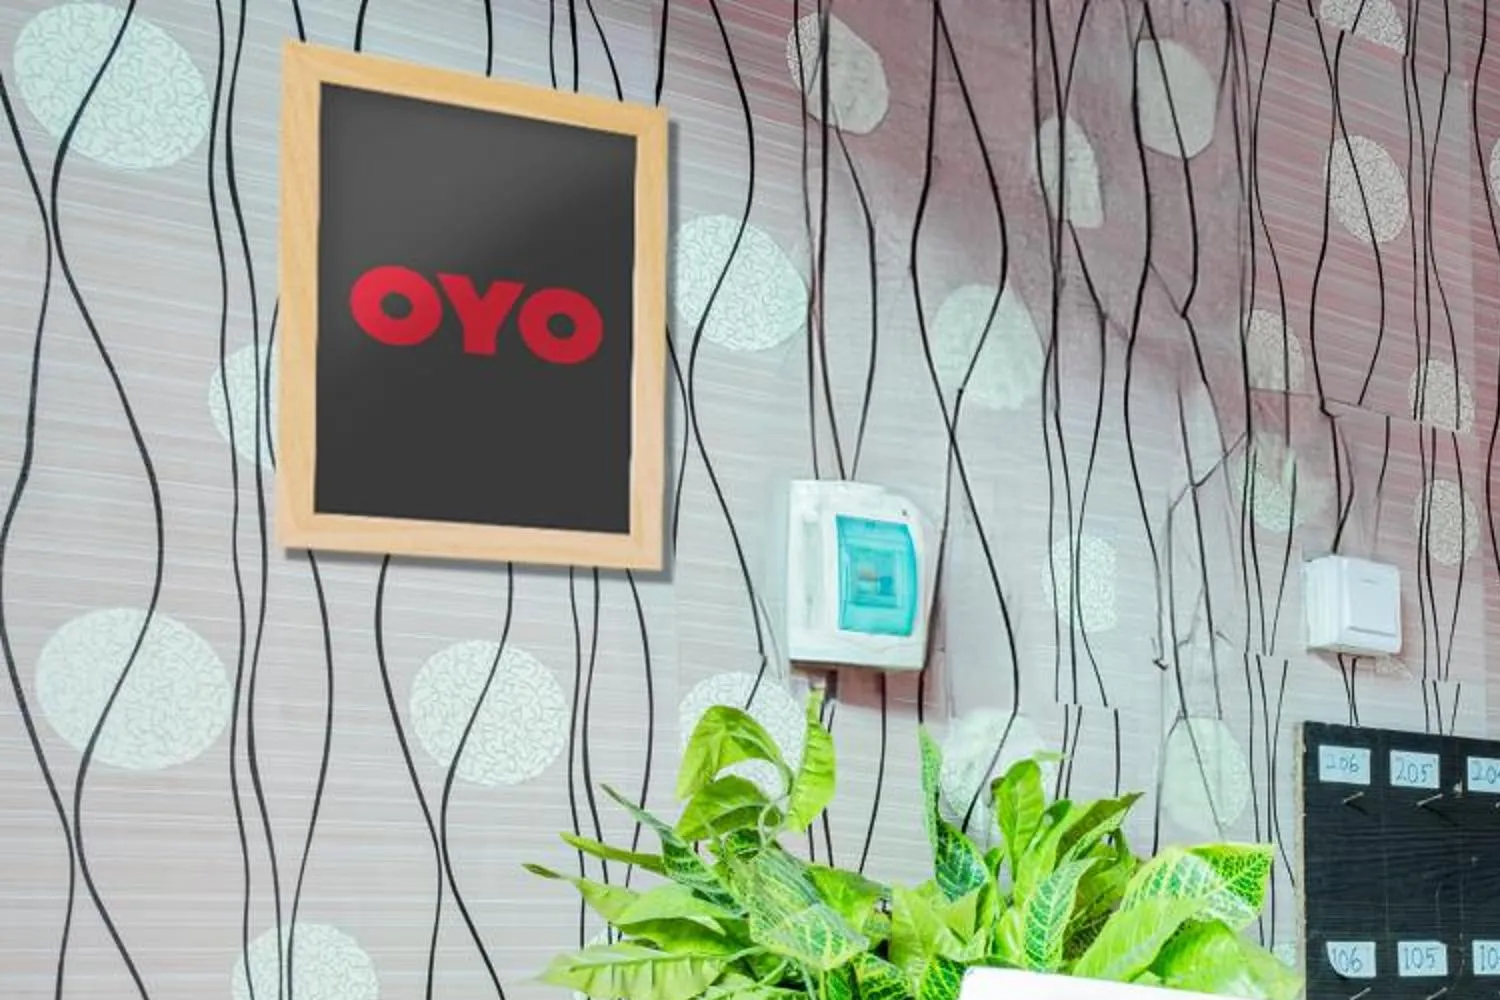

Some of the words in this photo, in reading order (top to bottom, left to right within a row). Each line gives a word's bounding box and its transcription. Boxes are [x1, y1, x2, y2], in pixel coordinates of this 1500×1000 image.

[350, 265, 604, 364] OYO
[1325, 752, 1360, 774] 206
[1395, 757, 1434, 784] 205
[1331, 947, 1363, 973] 106
[1403, 947, 1441, 970] 105
